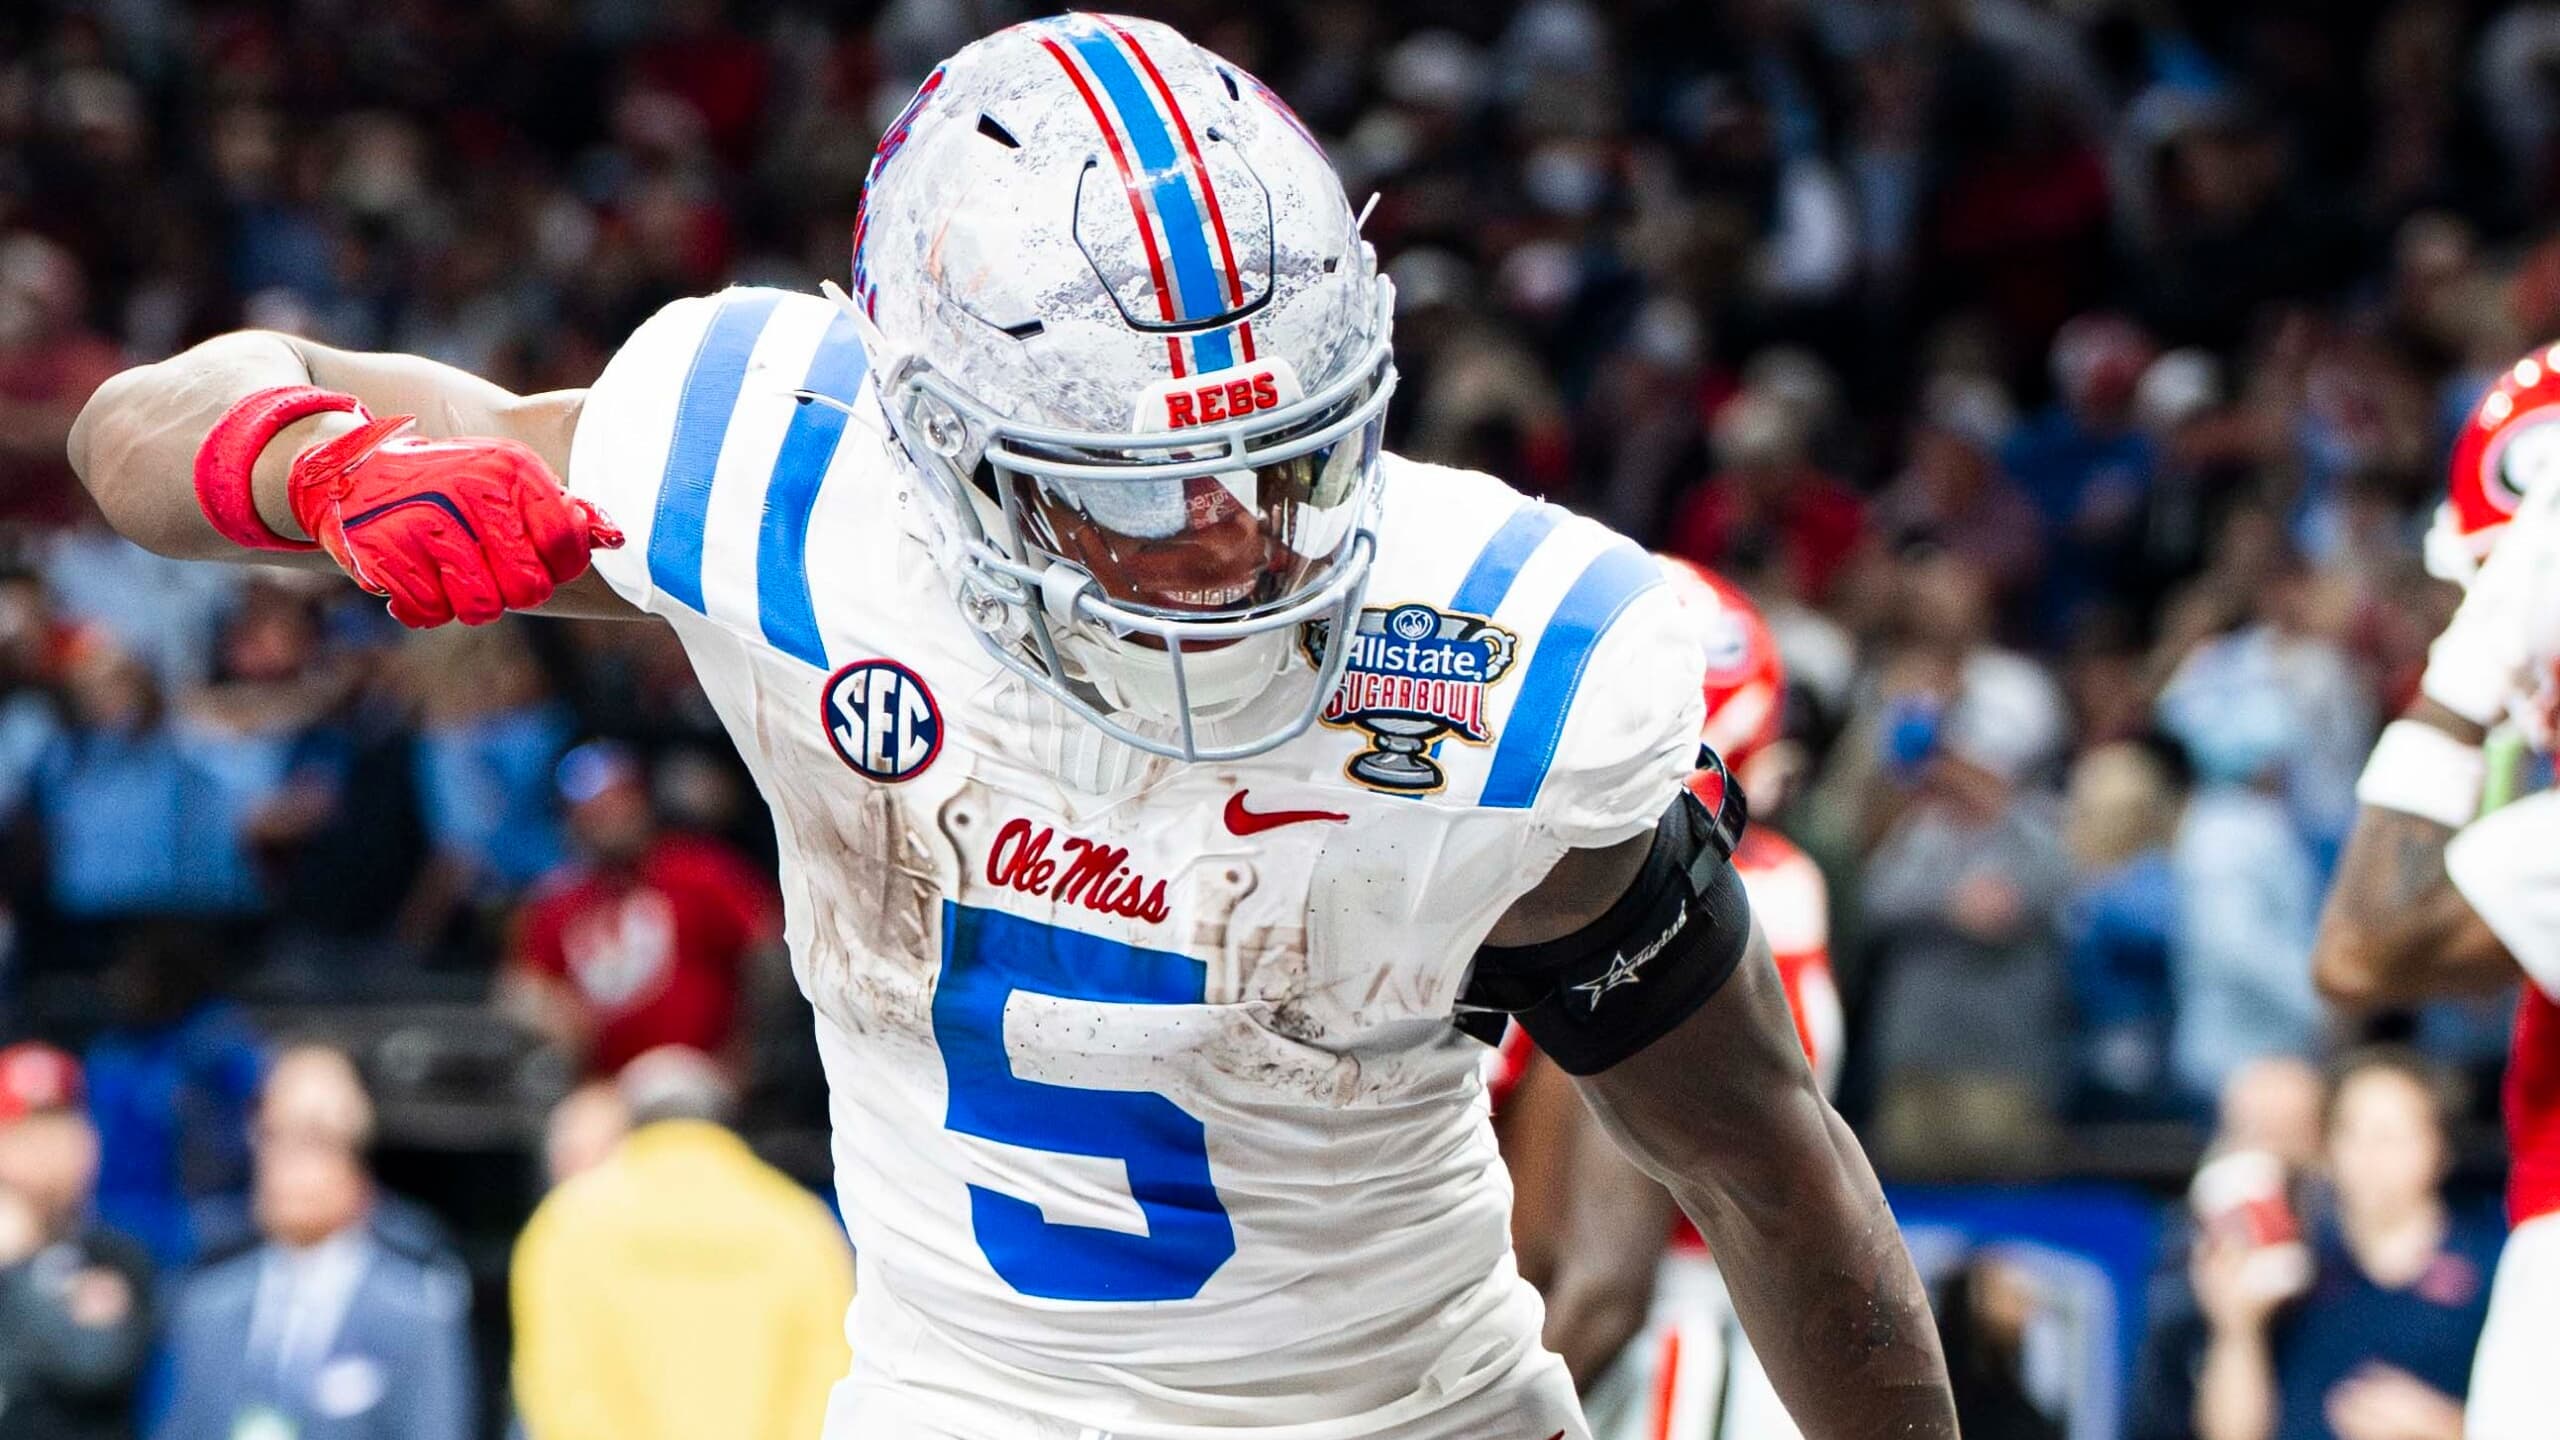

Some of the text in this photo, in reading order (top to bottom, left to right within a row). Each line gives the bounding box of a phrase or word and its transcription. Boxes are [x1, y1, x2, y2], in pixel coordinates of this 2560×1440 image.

[1164, 371, 1279, 430] REBS
[831, 667, 930, 774] SEC
[986, 817, 1171, 925] Ole Miss
[931, 898, 1237, 1303] 5
